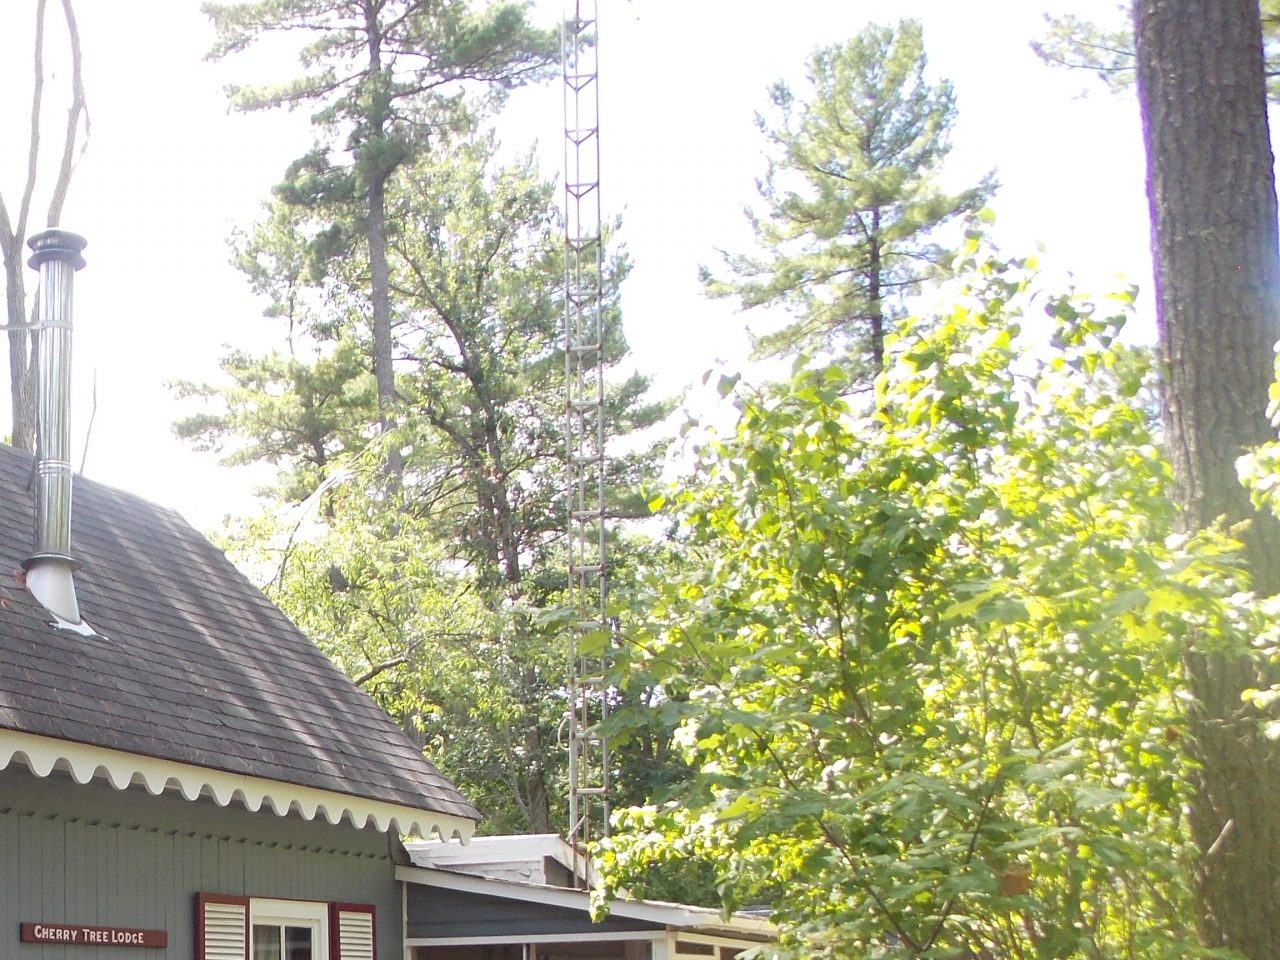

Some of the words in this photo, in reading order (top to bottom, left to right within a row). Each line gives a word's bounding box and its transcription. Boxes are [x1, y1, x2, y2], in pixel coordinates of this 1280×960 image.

[34, 925, 77, 941] CHERRY
[82, 928, 109, 942] TREE
[111, 930, 144, 944] LODGE
